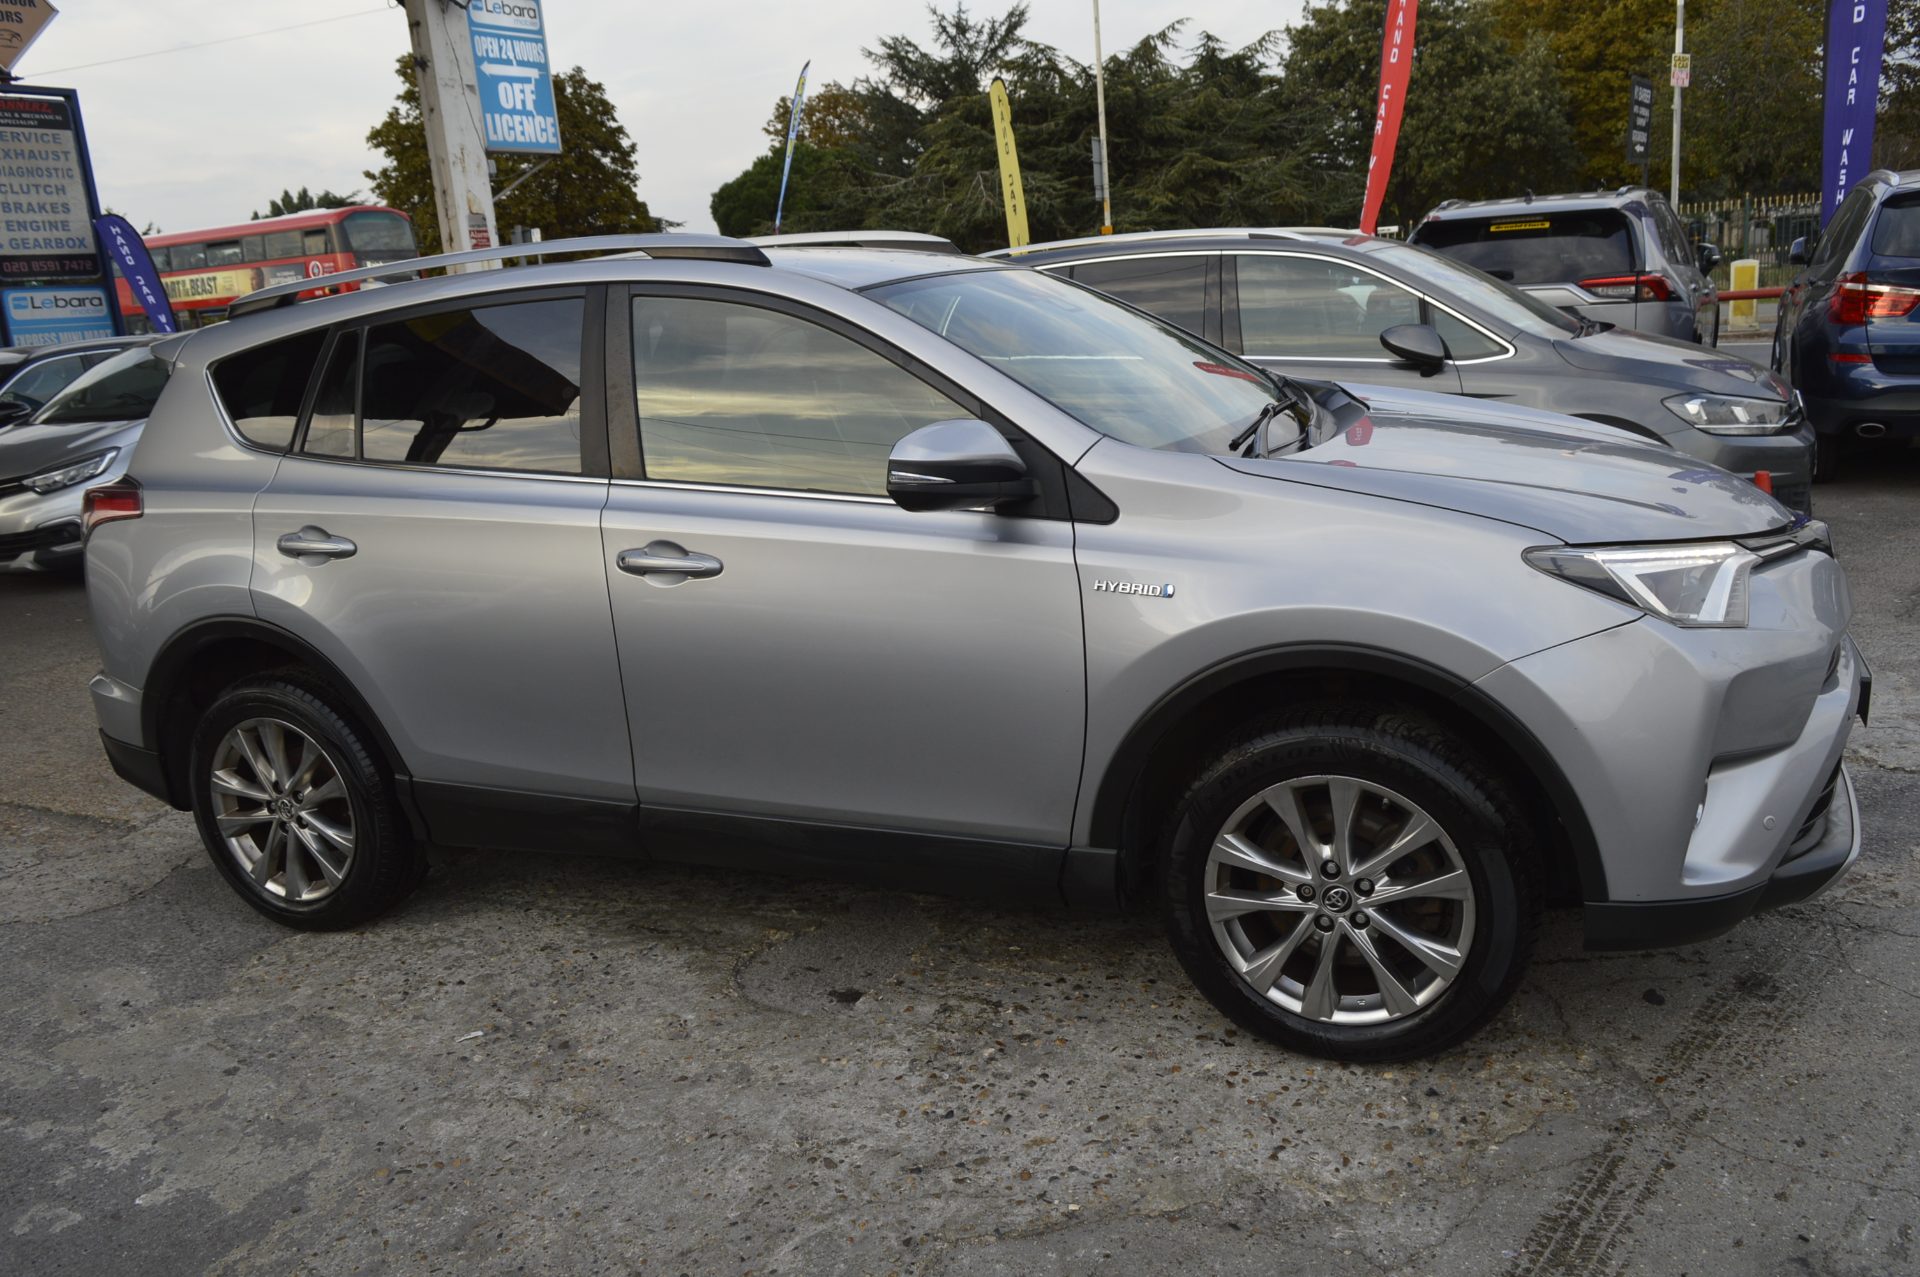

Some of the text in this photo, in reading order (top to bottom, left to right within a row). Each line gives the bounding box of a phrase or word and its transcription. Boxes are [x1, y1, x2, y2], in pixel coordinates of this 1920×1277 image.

[485, 0, 537, 19] Lebara
[474, 34, 545, 64] OPEN 24 HOURS
[497, 80, 536, 111] OFF
[1374, 84, 1391, 136] CAR
[485, 112, 558, 144] LICENCE
[1835, 47, 1861, 206] CAR WASH
[0, 147, 71, 162] XHAUST
[0, 182, 66, 196] CLUTCH
[1, 201, 71, 214] BRAKES
[5, 219, 71, 233] ENGINE
[9, 237, 88, 251] GEARBOX
[190, 275, 218, 297] BEAST
[29, 294, 104, 310] Lebara
[1093, 579, 1161, 597] HYBRID
